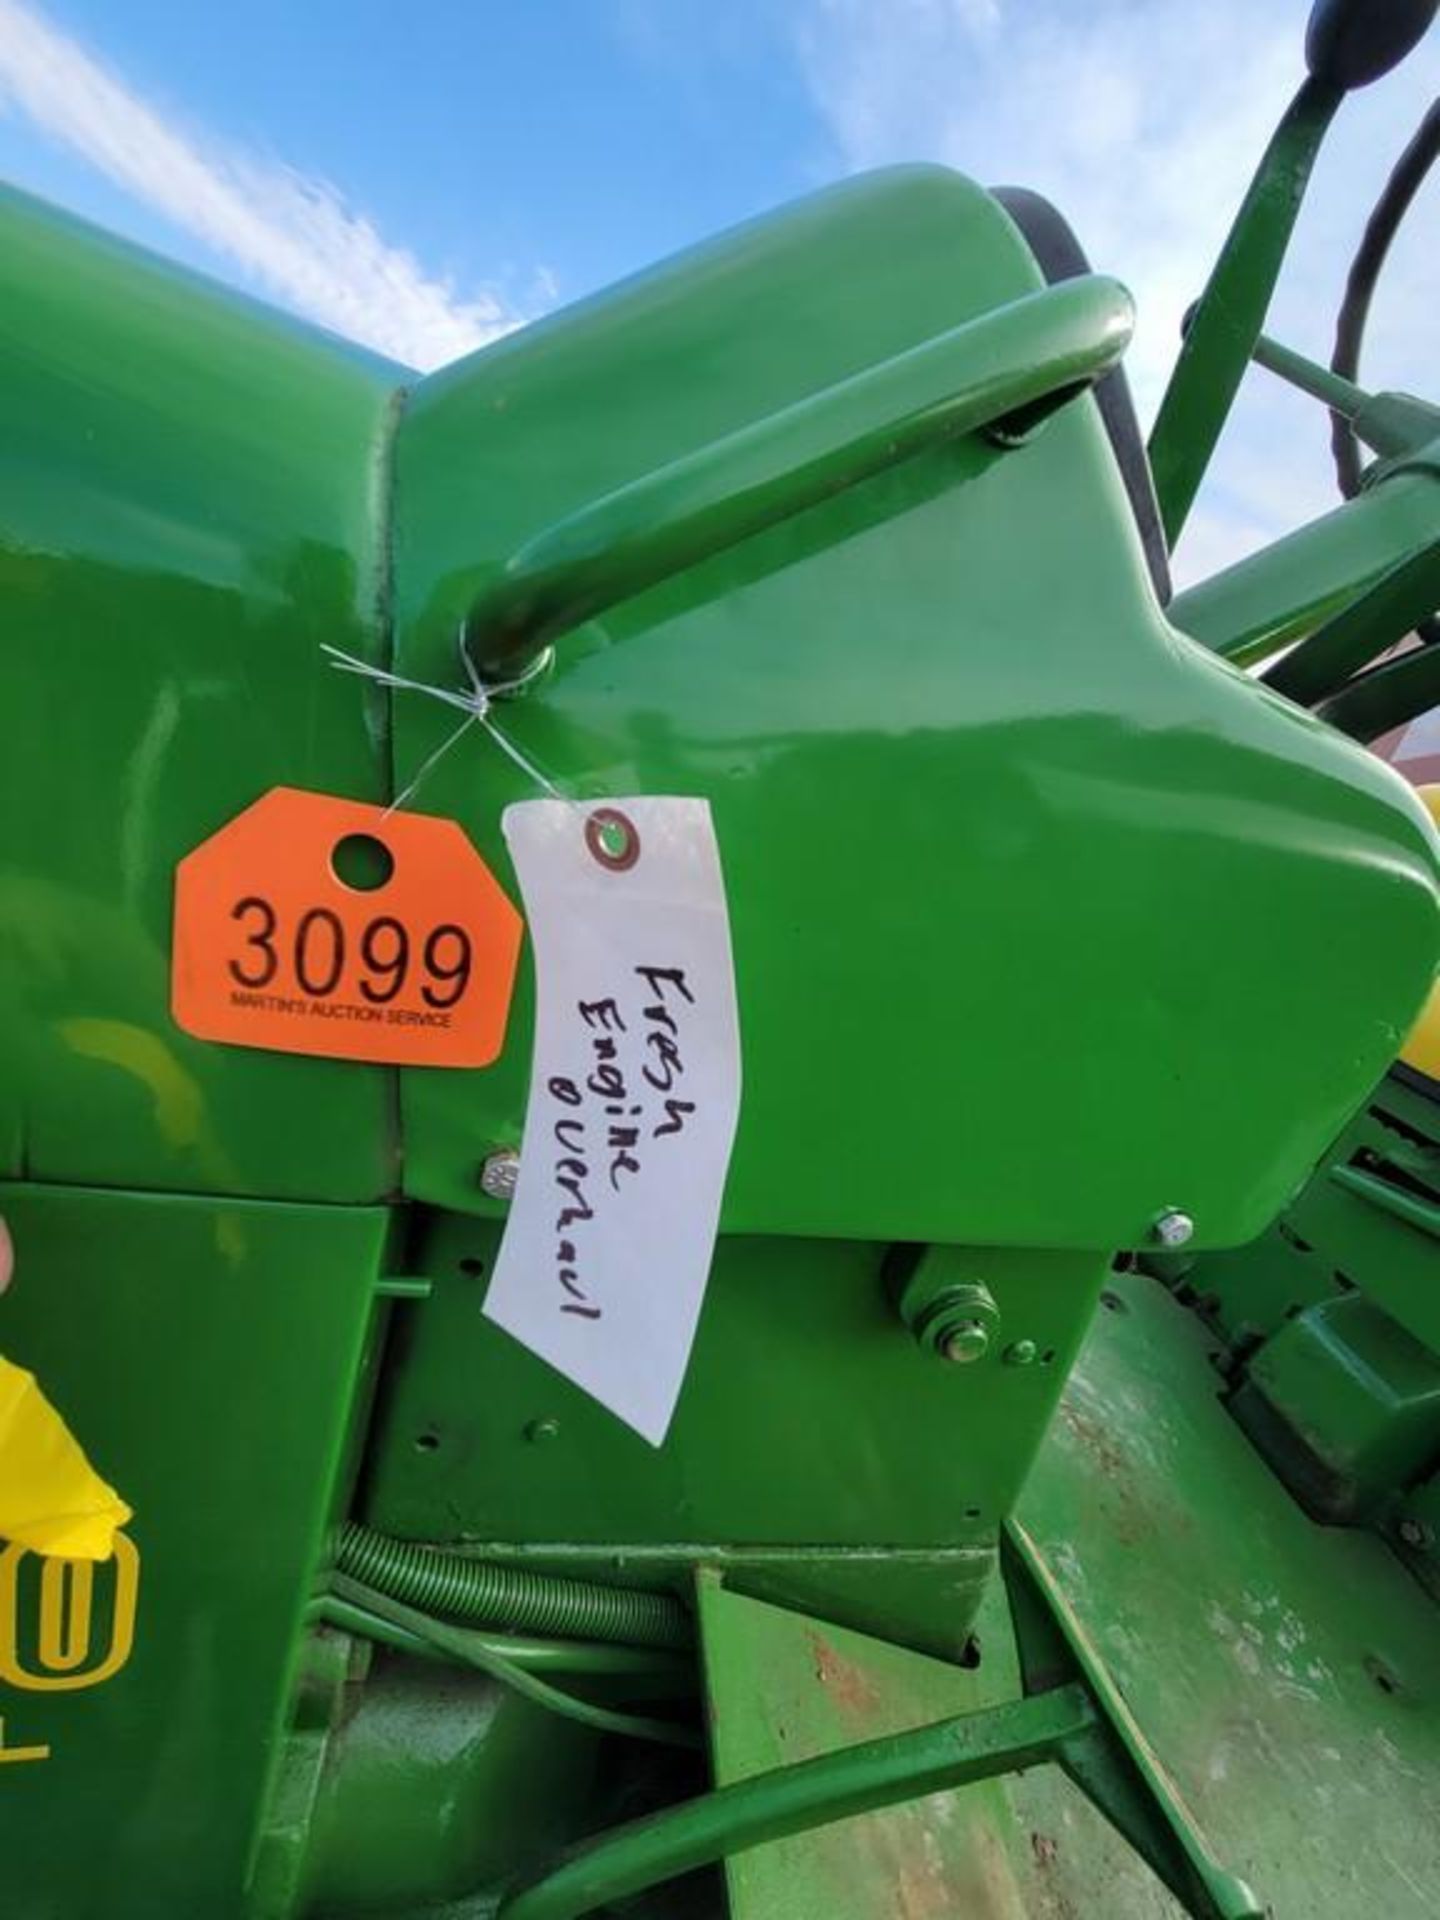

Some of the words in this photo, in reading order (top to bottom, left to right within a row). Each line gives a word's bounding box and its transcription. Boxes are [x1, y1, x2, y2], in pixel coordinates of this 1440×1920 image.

[229, 896, 472, 1008] 3099
[310, 1002, 382, 1022] AUCTION
[386, 1010, 452, 1028] SERVICE
[578, 998, 642, 1192] Engine
[635, 966, 696, 1139] Fresh
